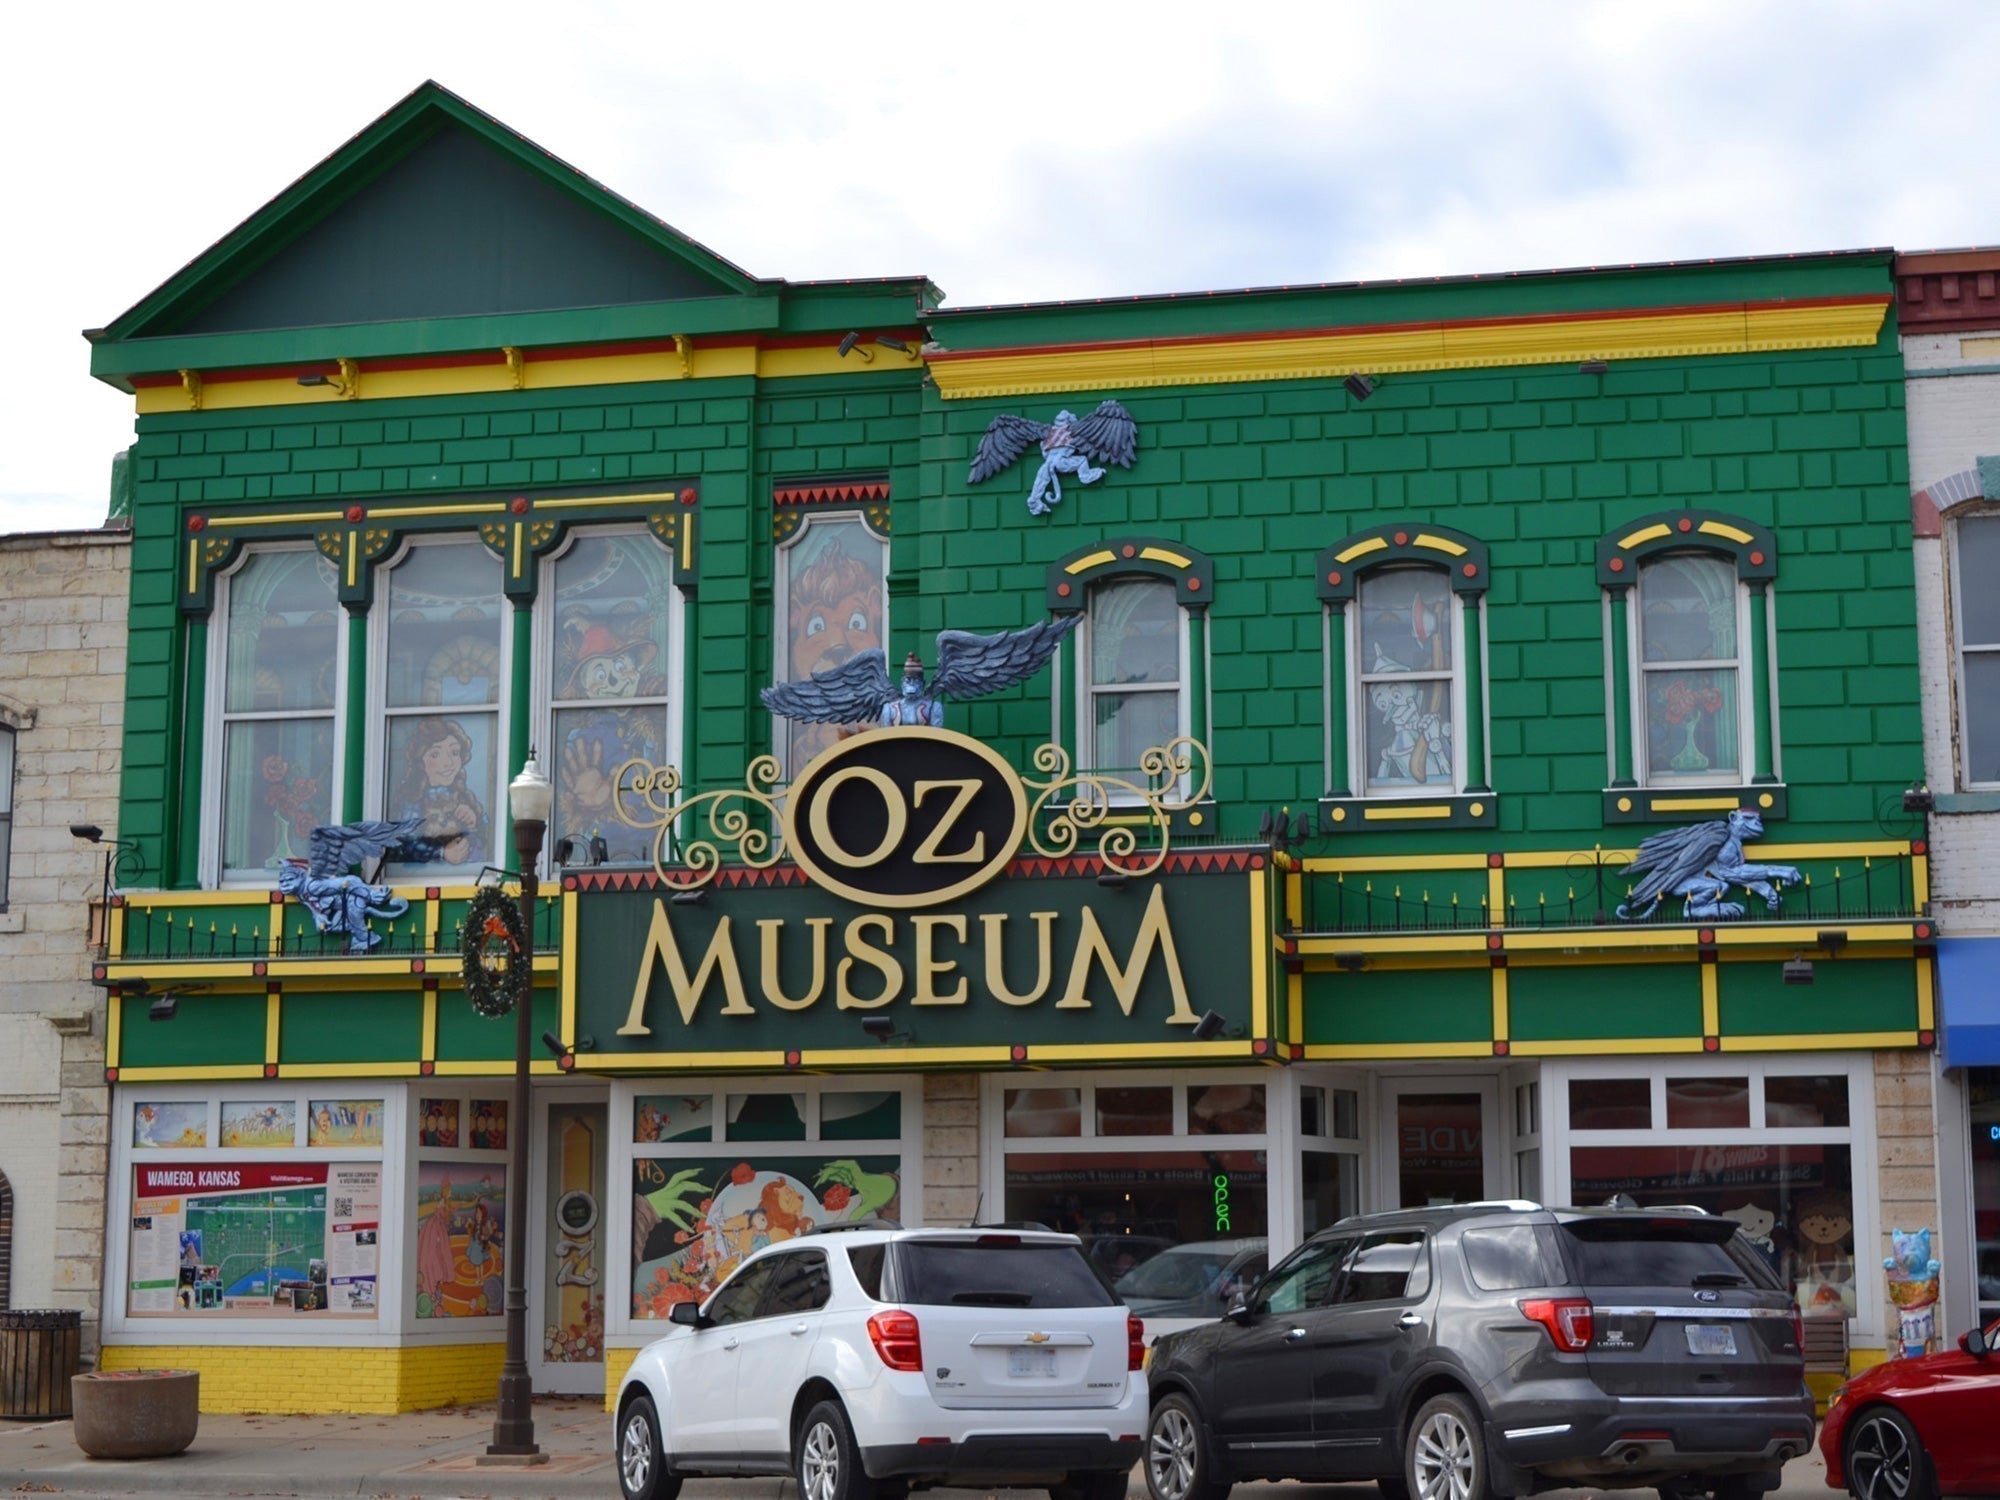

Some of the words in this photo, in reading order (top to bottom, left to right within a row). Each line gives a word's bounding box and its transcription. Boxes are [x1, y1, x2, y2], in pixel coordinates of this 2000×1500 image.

[809, 766, 986, 868] OZ
[617, 883, 1202, 1036] MUSEUM
[147, 1170, 197, 1189] WAMEGO,
[198, 1170, 241, 1187] KANSAS
